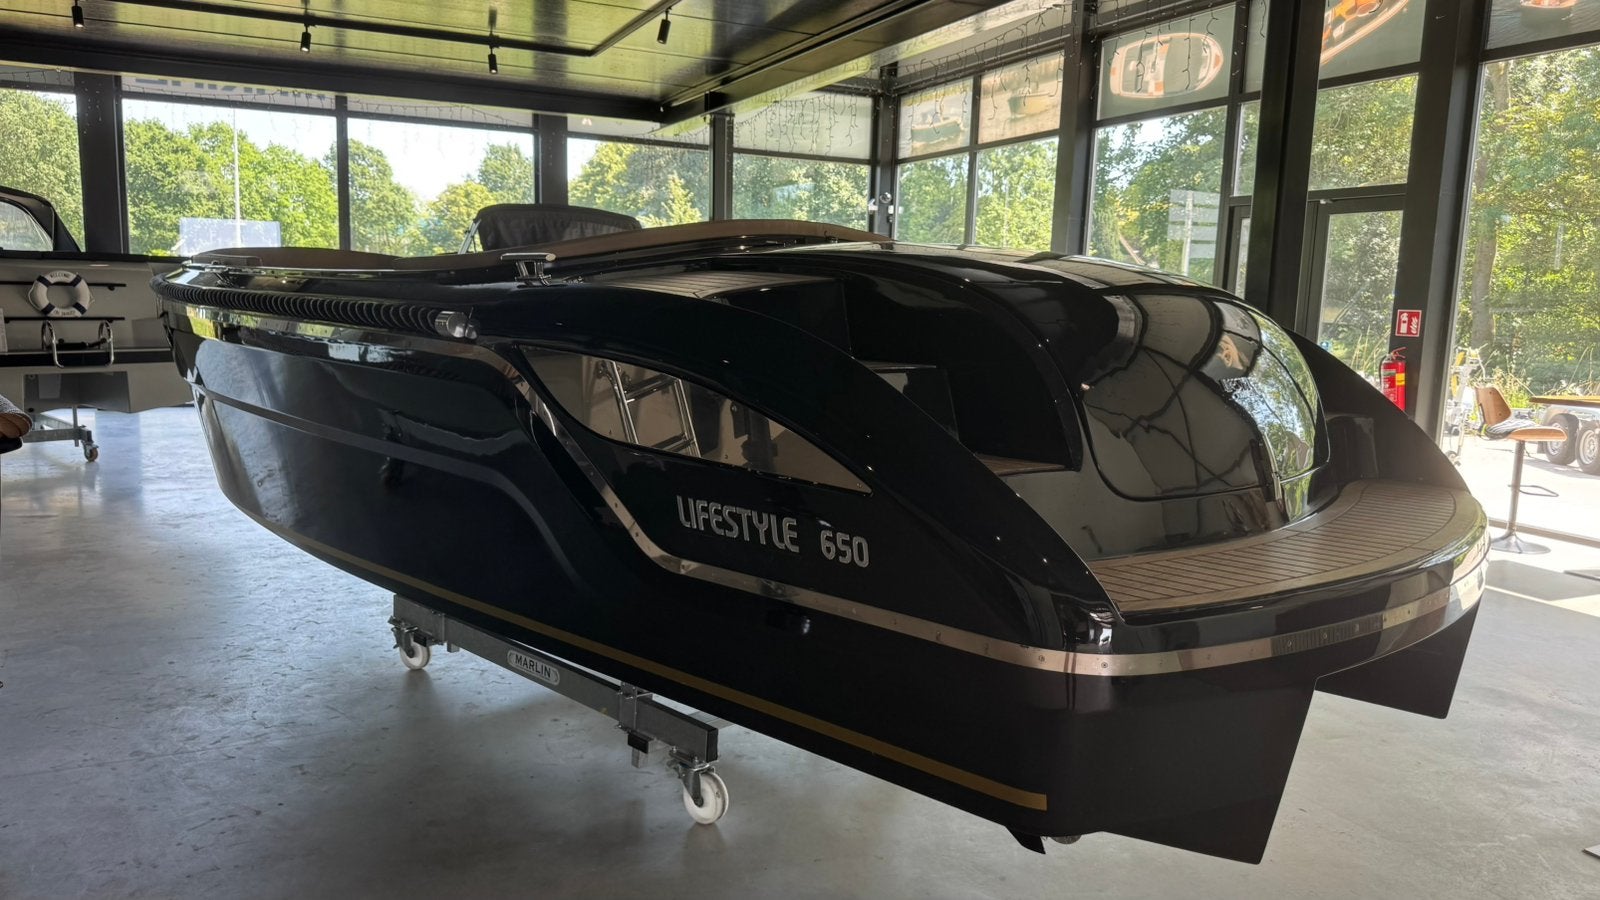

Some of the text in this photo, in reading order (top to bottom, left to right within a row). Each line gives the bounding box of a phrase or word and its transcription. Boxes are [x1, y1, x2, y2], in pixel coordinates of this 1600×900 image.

[676, 495, 870, 568] LIFESTYLE 650
[515, 653, 551, 678] MARLIN
